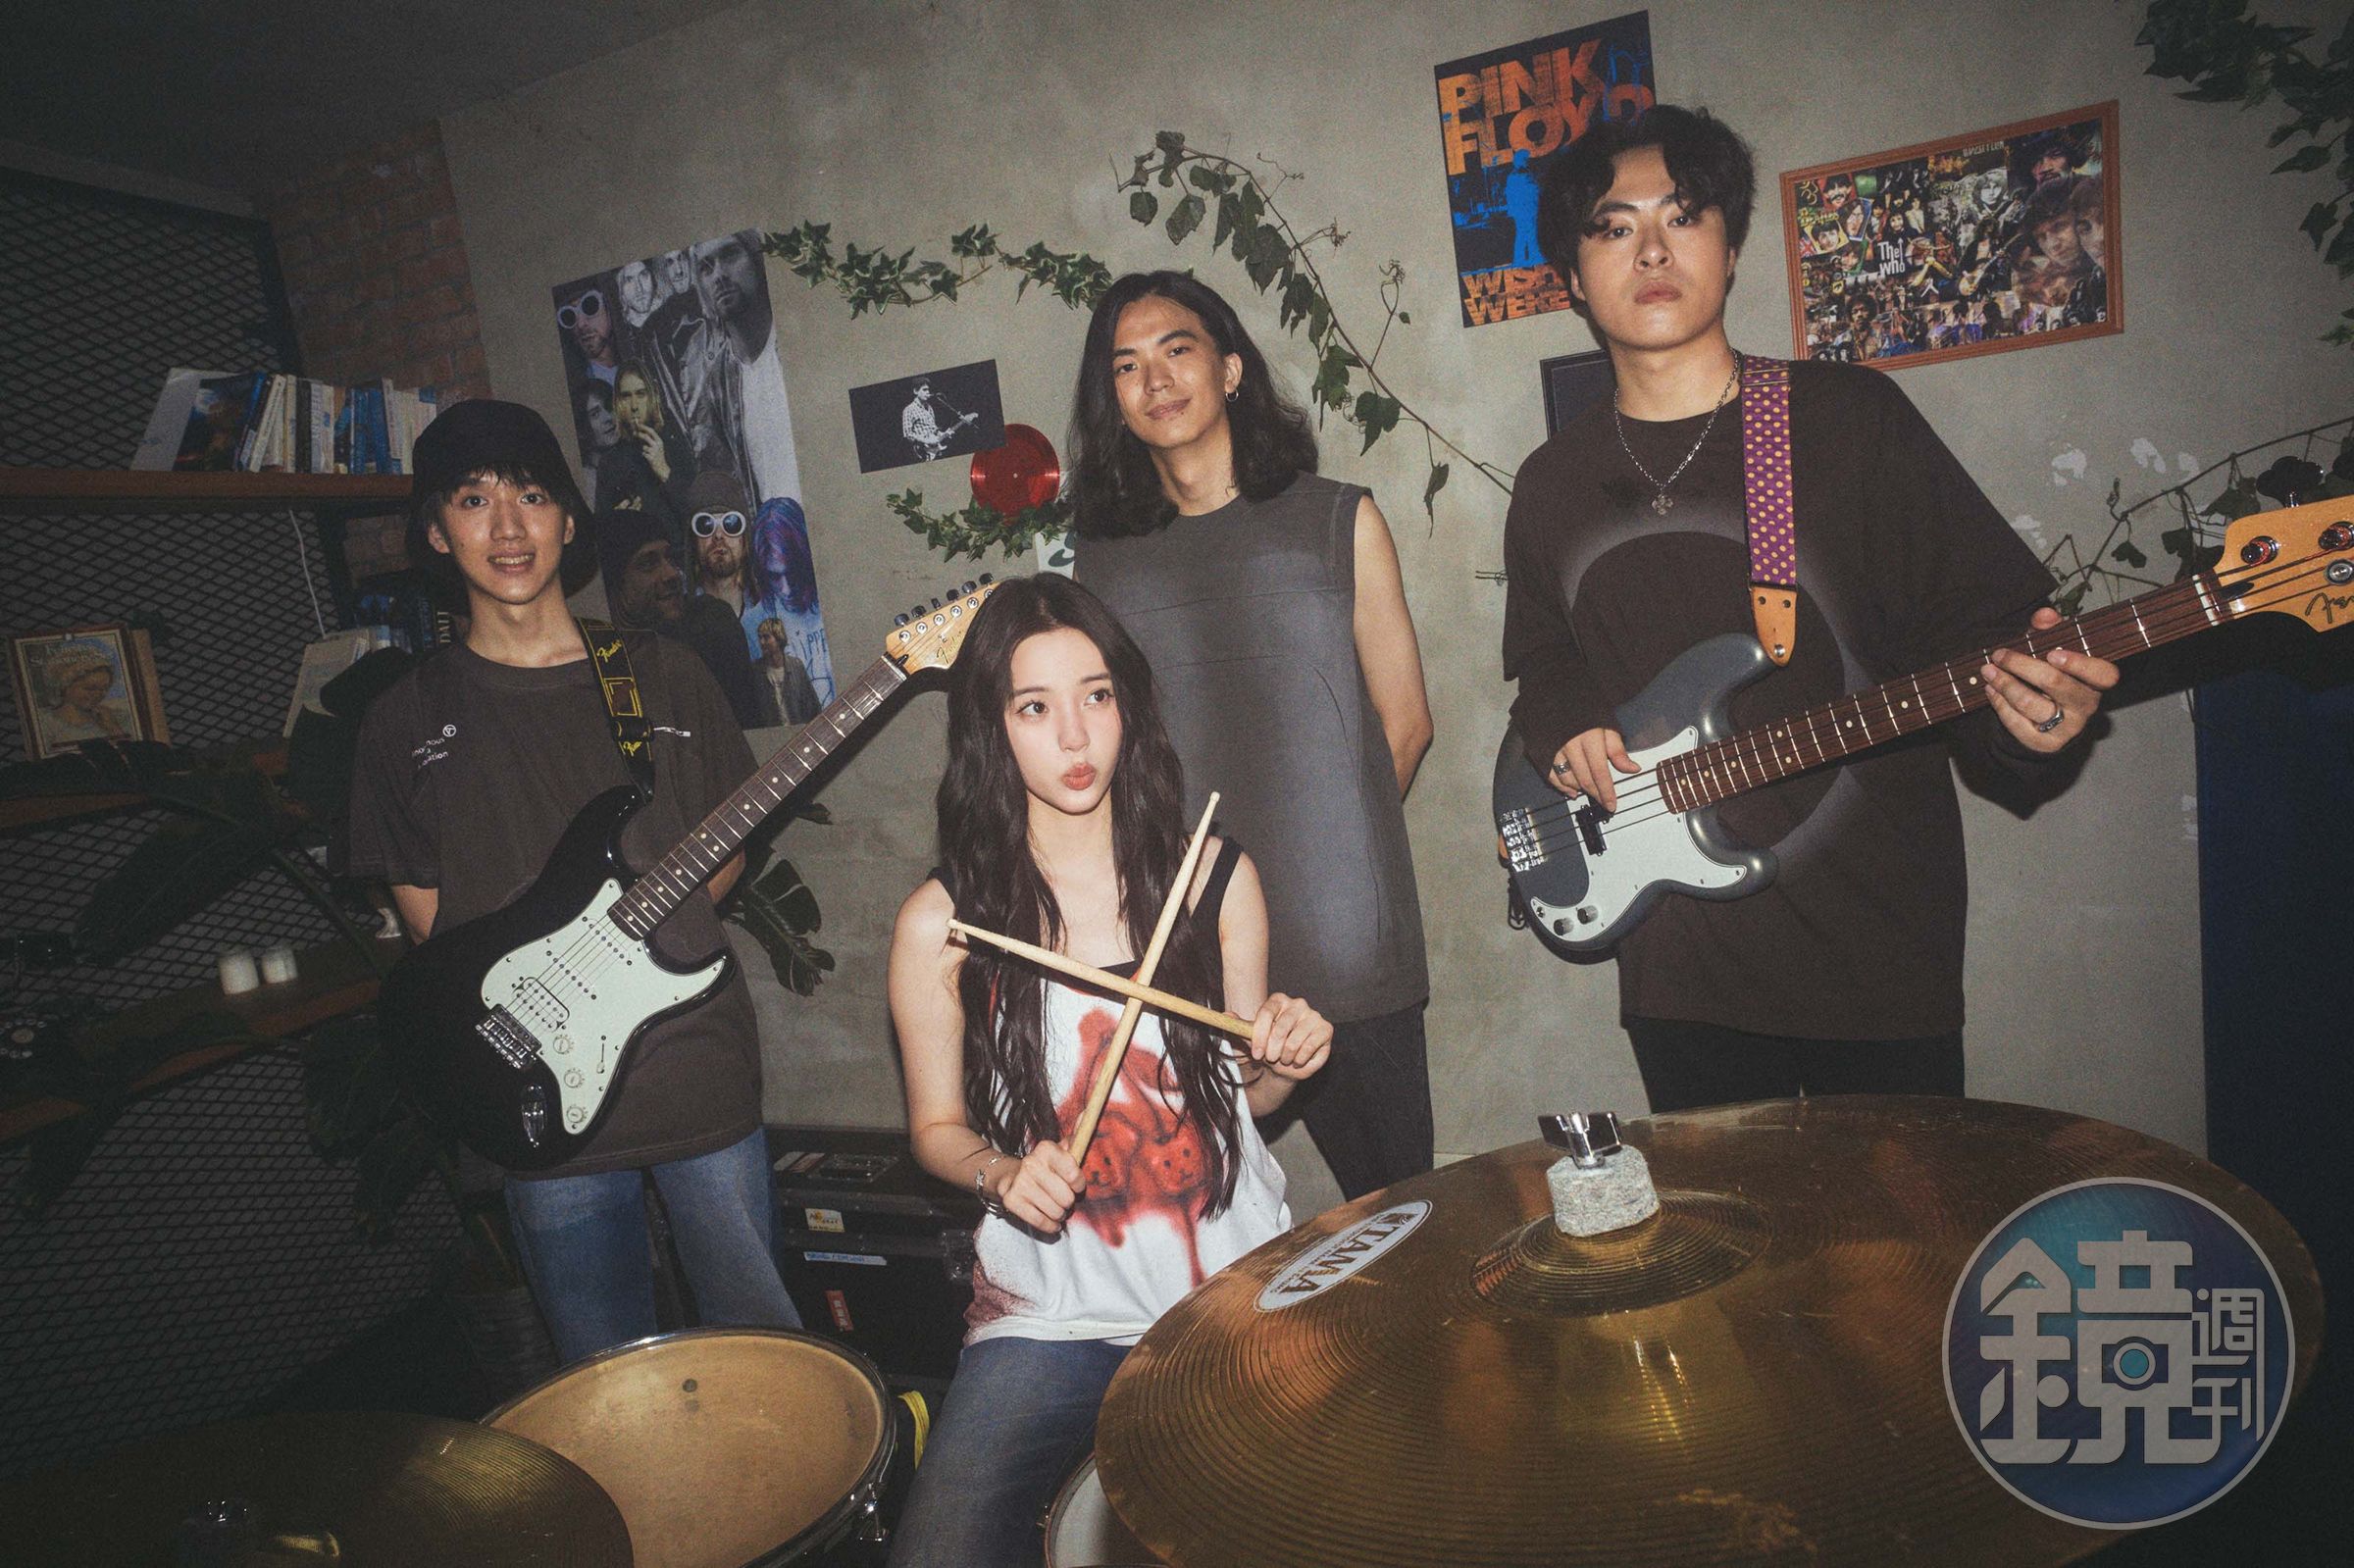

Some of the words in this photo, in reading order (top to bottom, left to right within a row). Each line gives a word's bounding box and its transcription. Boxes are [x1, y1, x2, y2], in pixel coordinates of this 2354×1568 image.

[1438, 37, 1607, 120] PINK
[1877, 241, 1900, 261] The
[1278, 1226, 1401, 1293] TAMA
